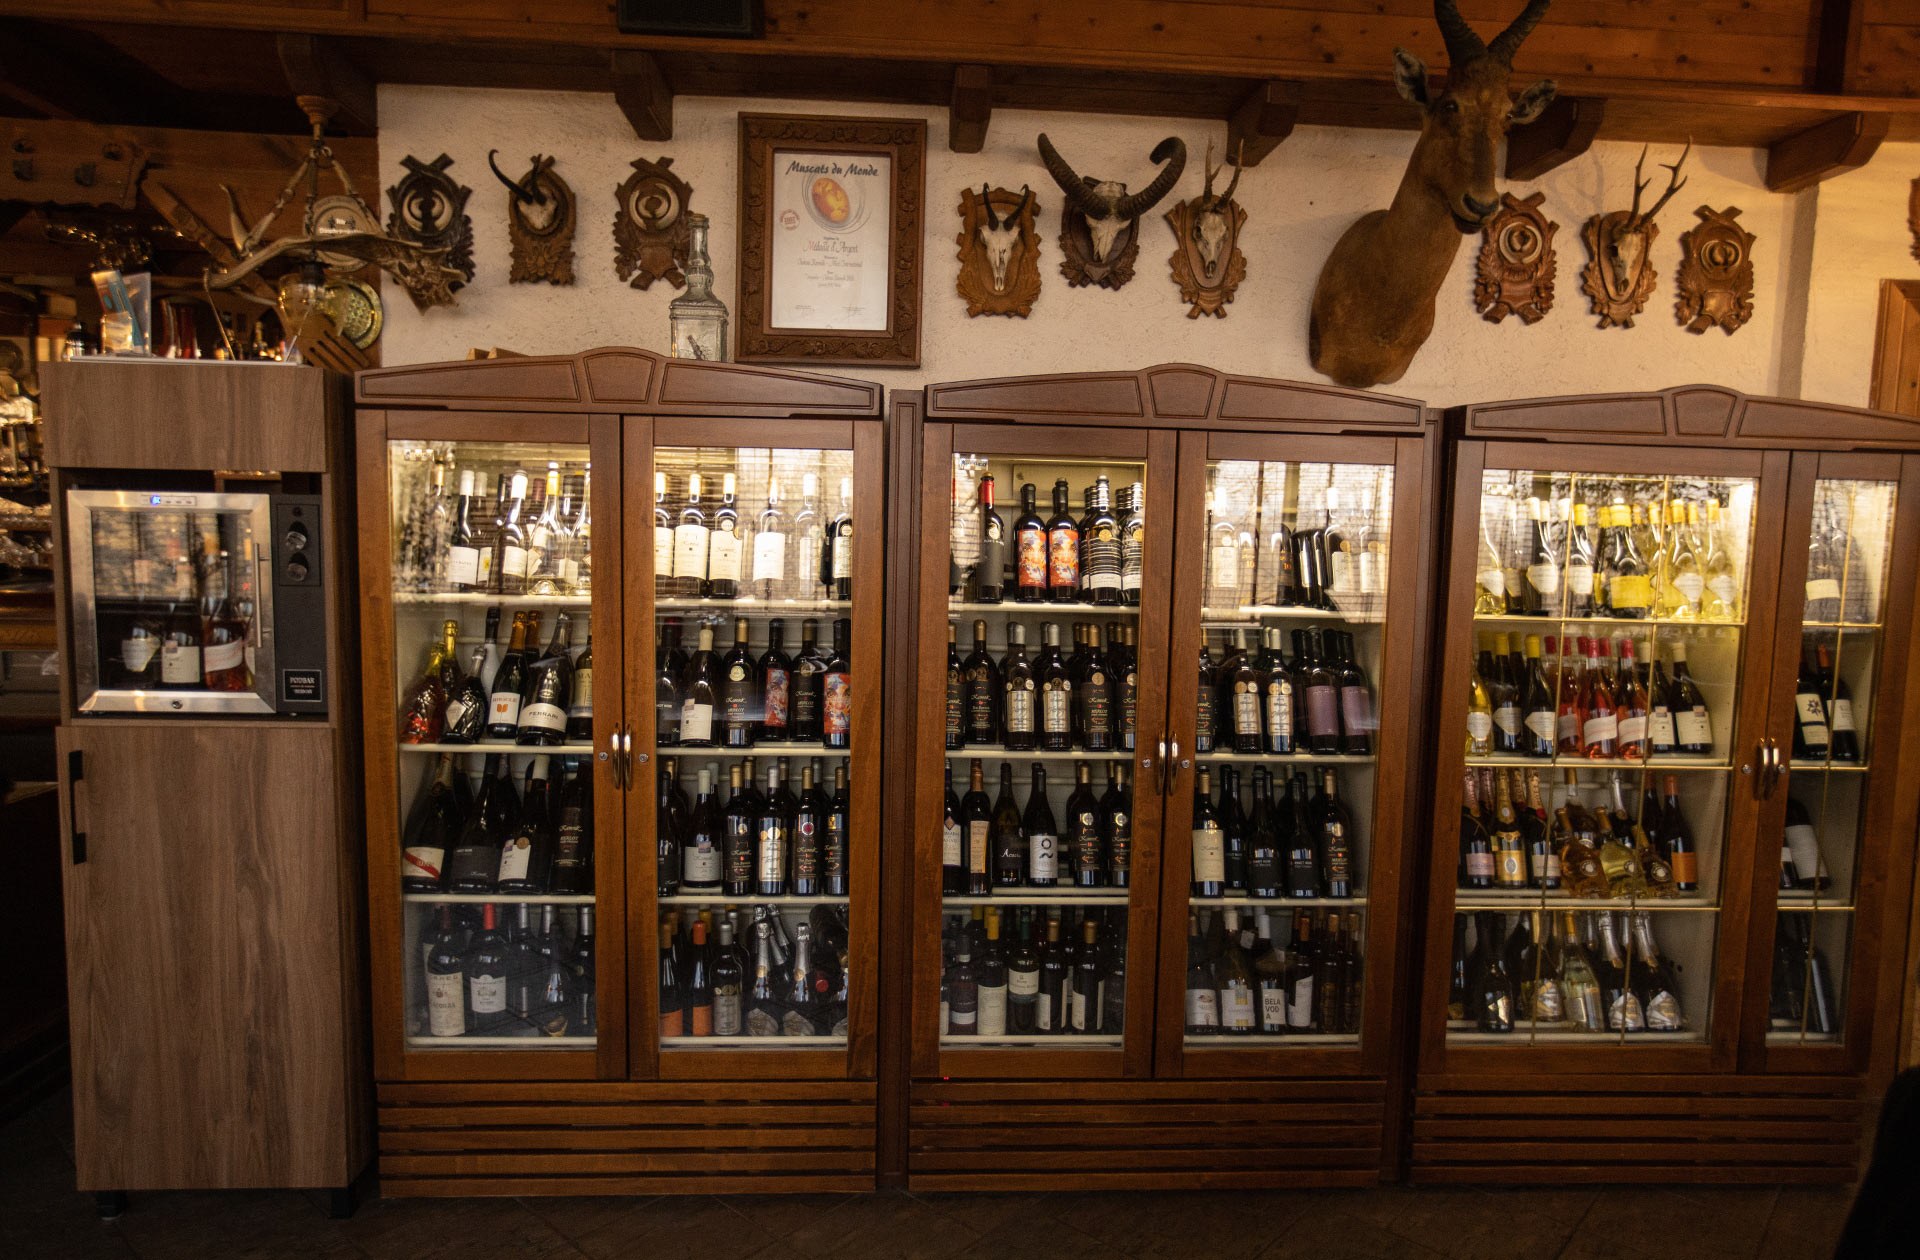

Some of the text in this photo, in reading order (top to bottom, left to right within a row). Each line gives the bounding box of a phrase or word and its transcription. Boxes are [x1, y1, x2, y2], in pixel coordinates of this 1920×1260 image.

[785, 160, 878, 177] Muscats du Monde
[529, 711, 558, 719] FERRARI
